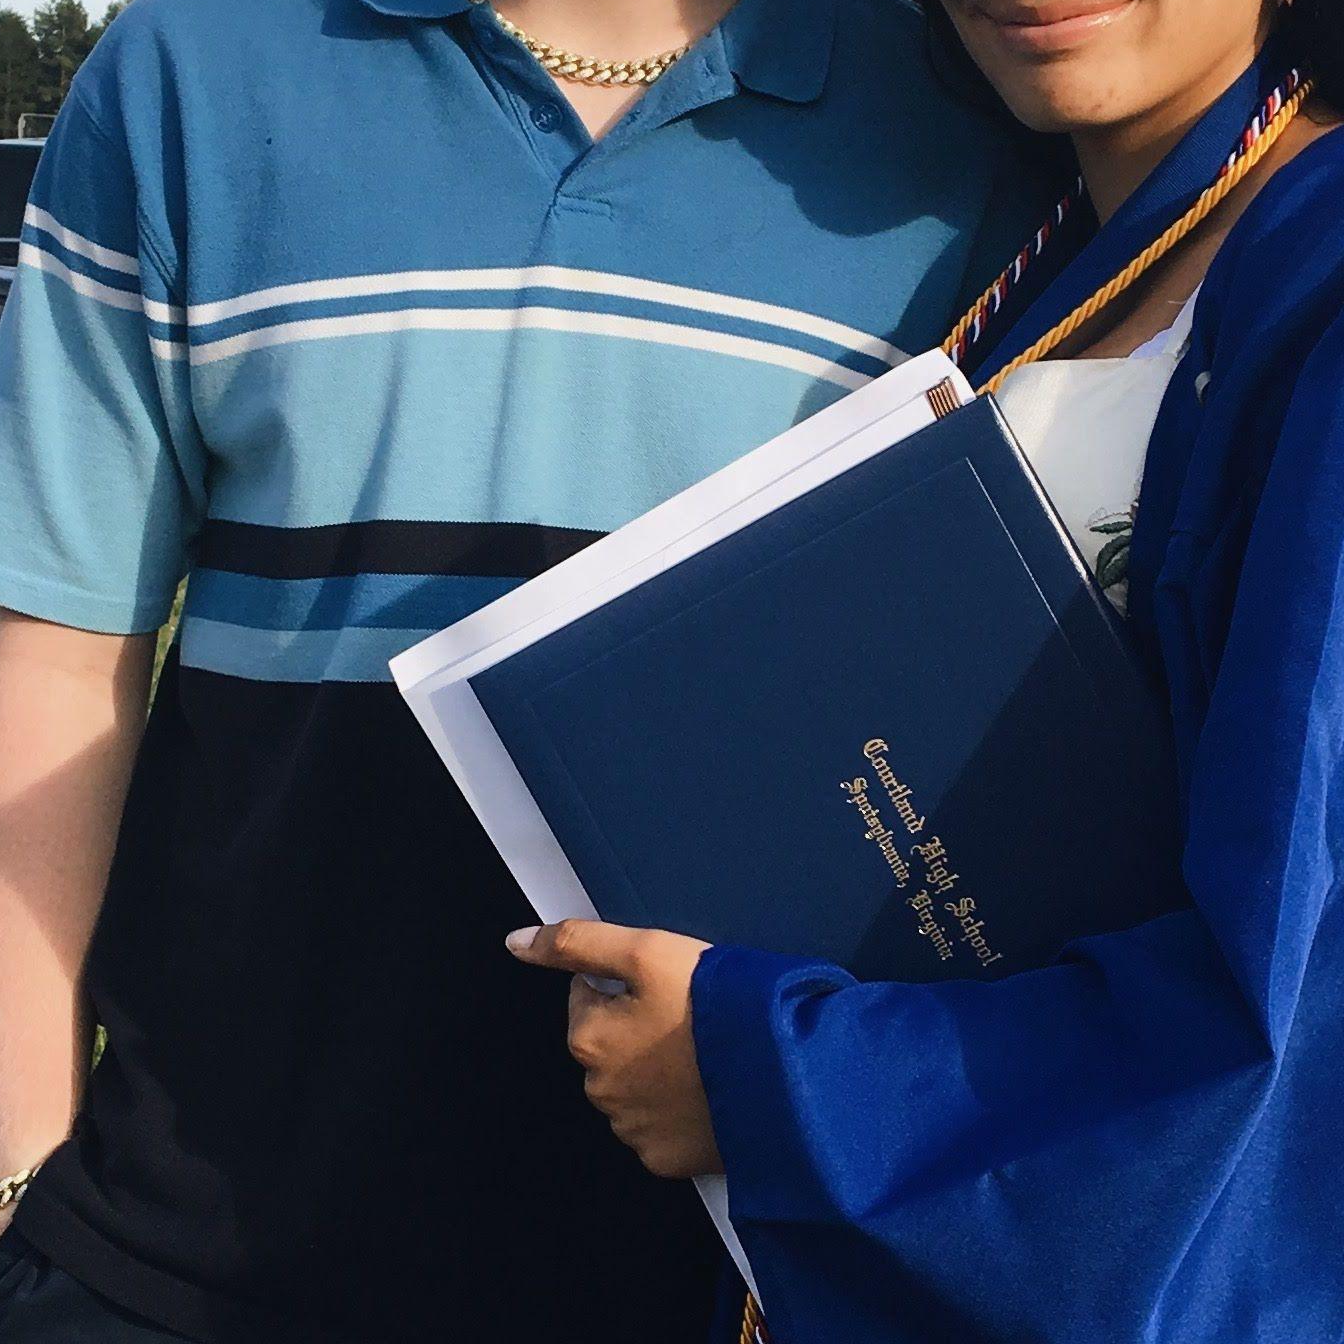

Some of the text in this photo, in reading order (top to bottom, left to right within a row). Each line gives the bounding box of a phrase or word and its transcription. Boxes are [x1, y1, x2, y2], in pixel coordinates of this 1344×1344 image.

[863, 738, 1003, 967] Courtland High School
[905, 889, 954, 961] Virginia
